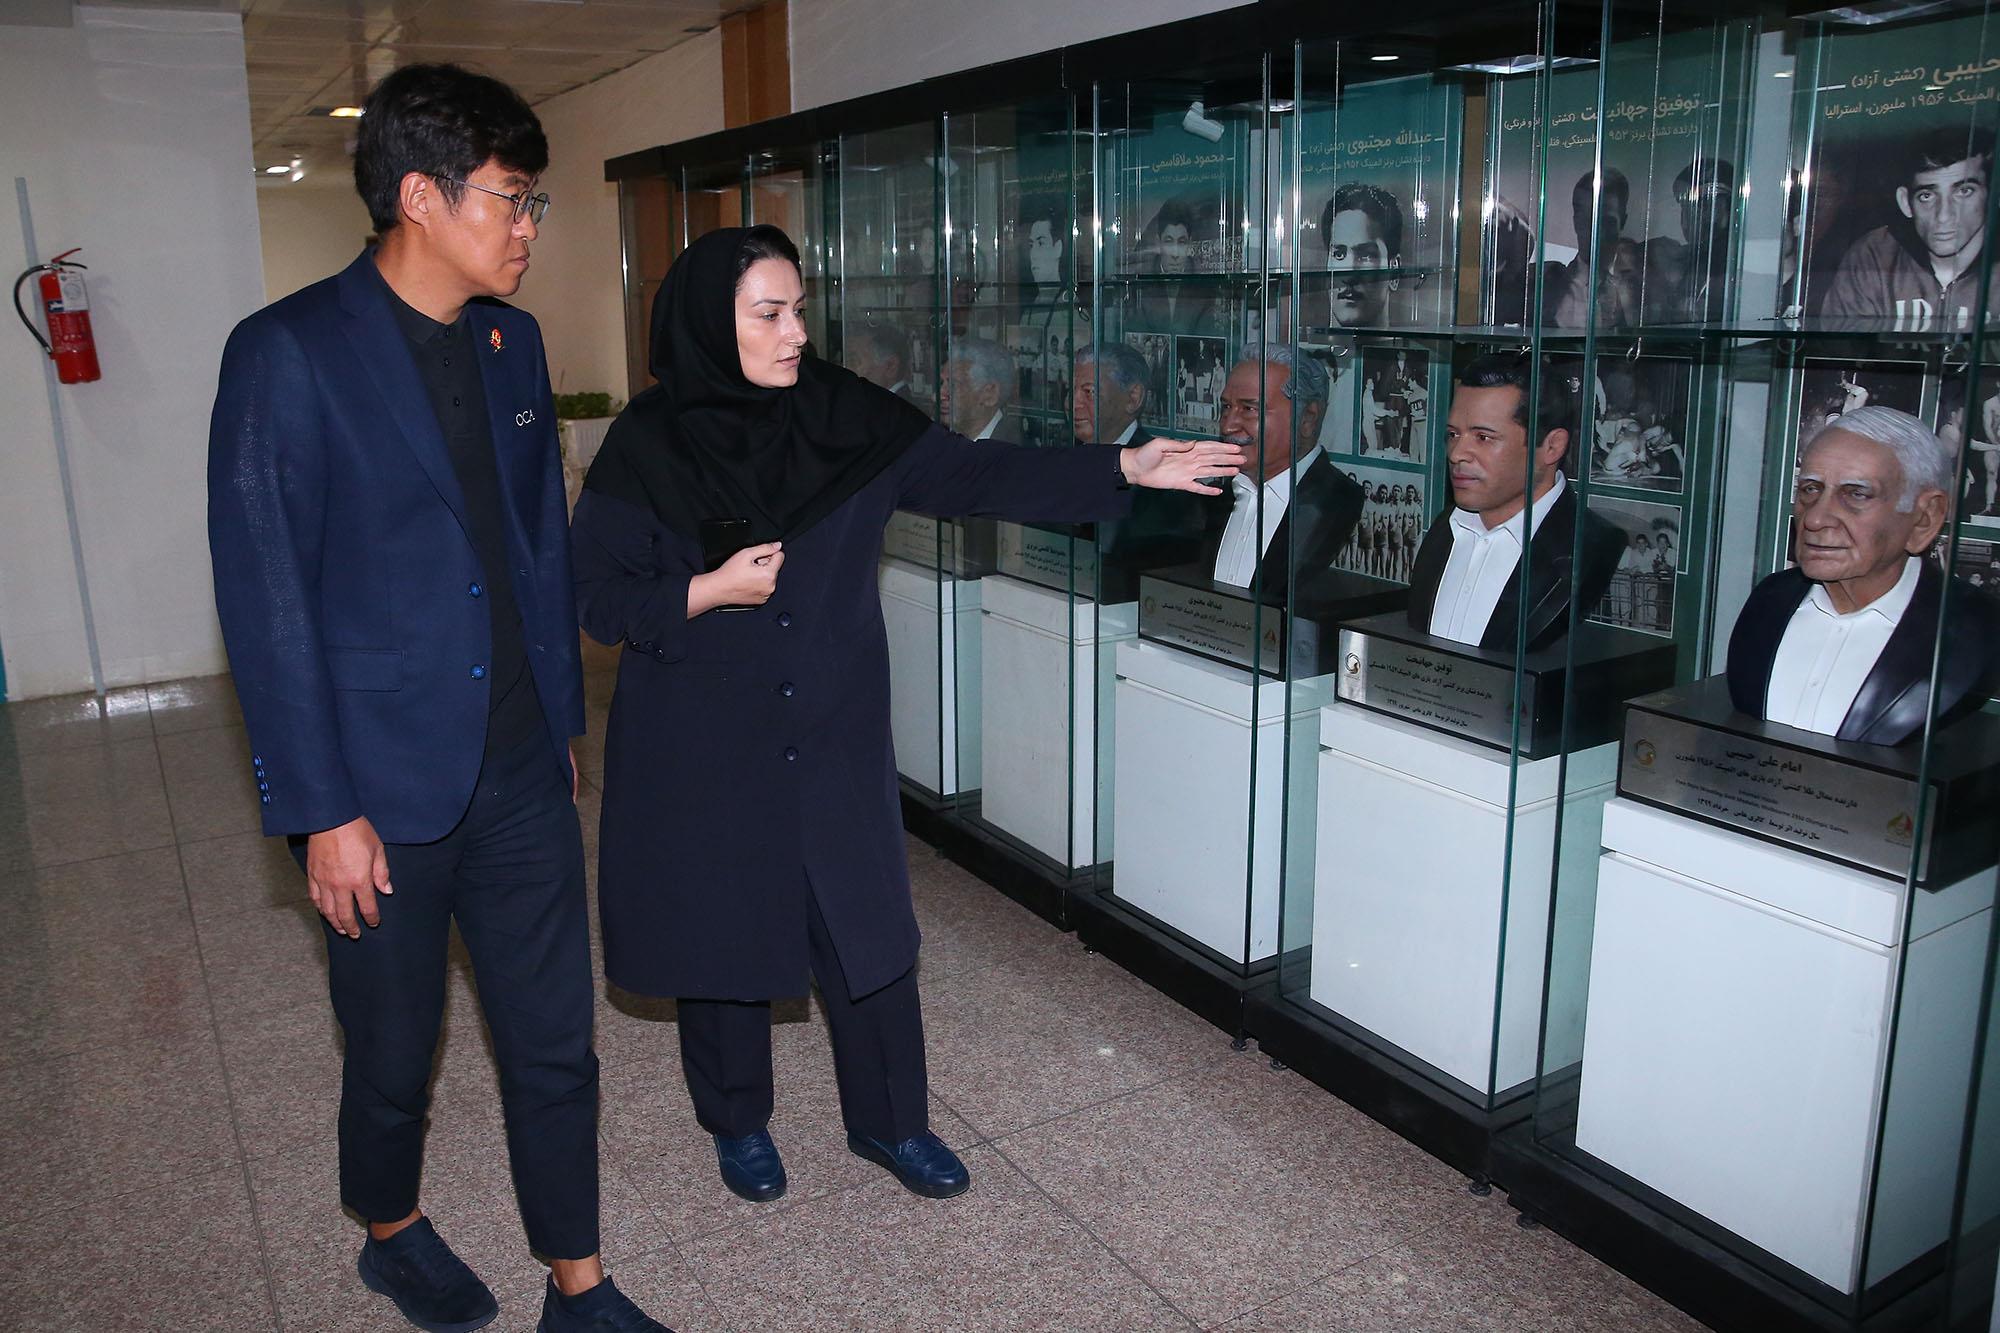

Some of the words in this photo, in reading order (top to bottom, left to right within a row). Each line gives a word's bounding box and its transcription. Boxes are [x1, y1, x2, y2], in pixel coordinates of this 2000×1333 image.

[1655, 92, 1701, 119] توفیق
[1347, 135, 1392, 155] مجتبوی
[1395, 129, 1432, 146] عبدالله
